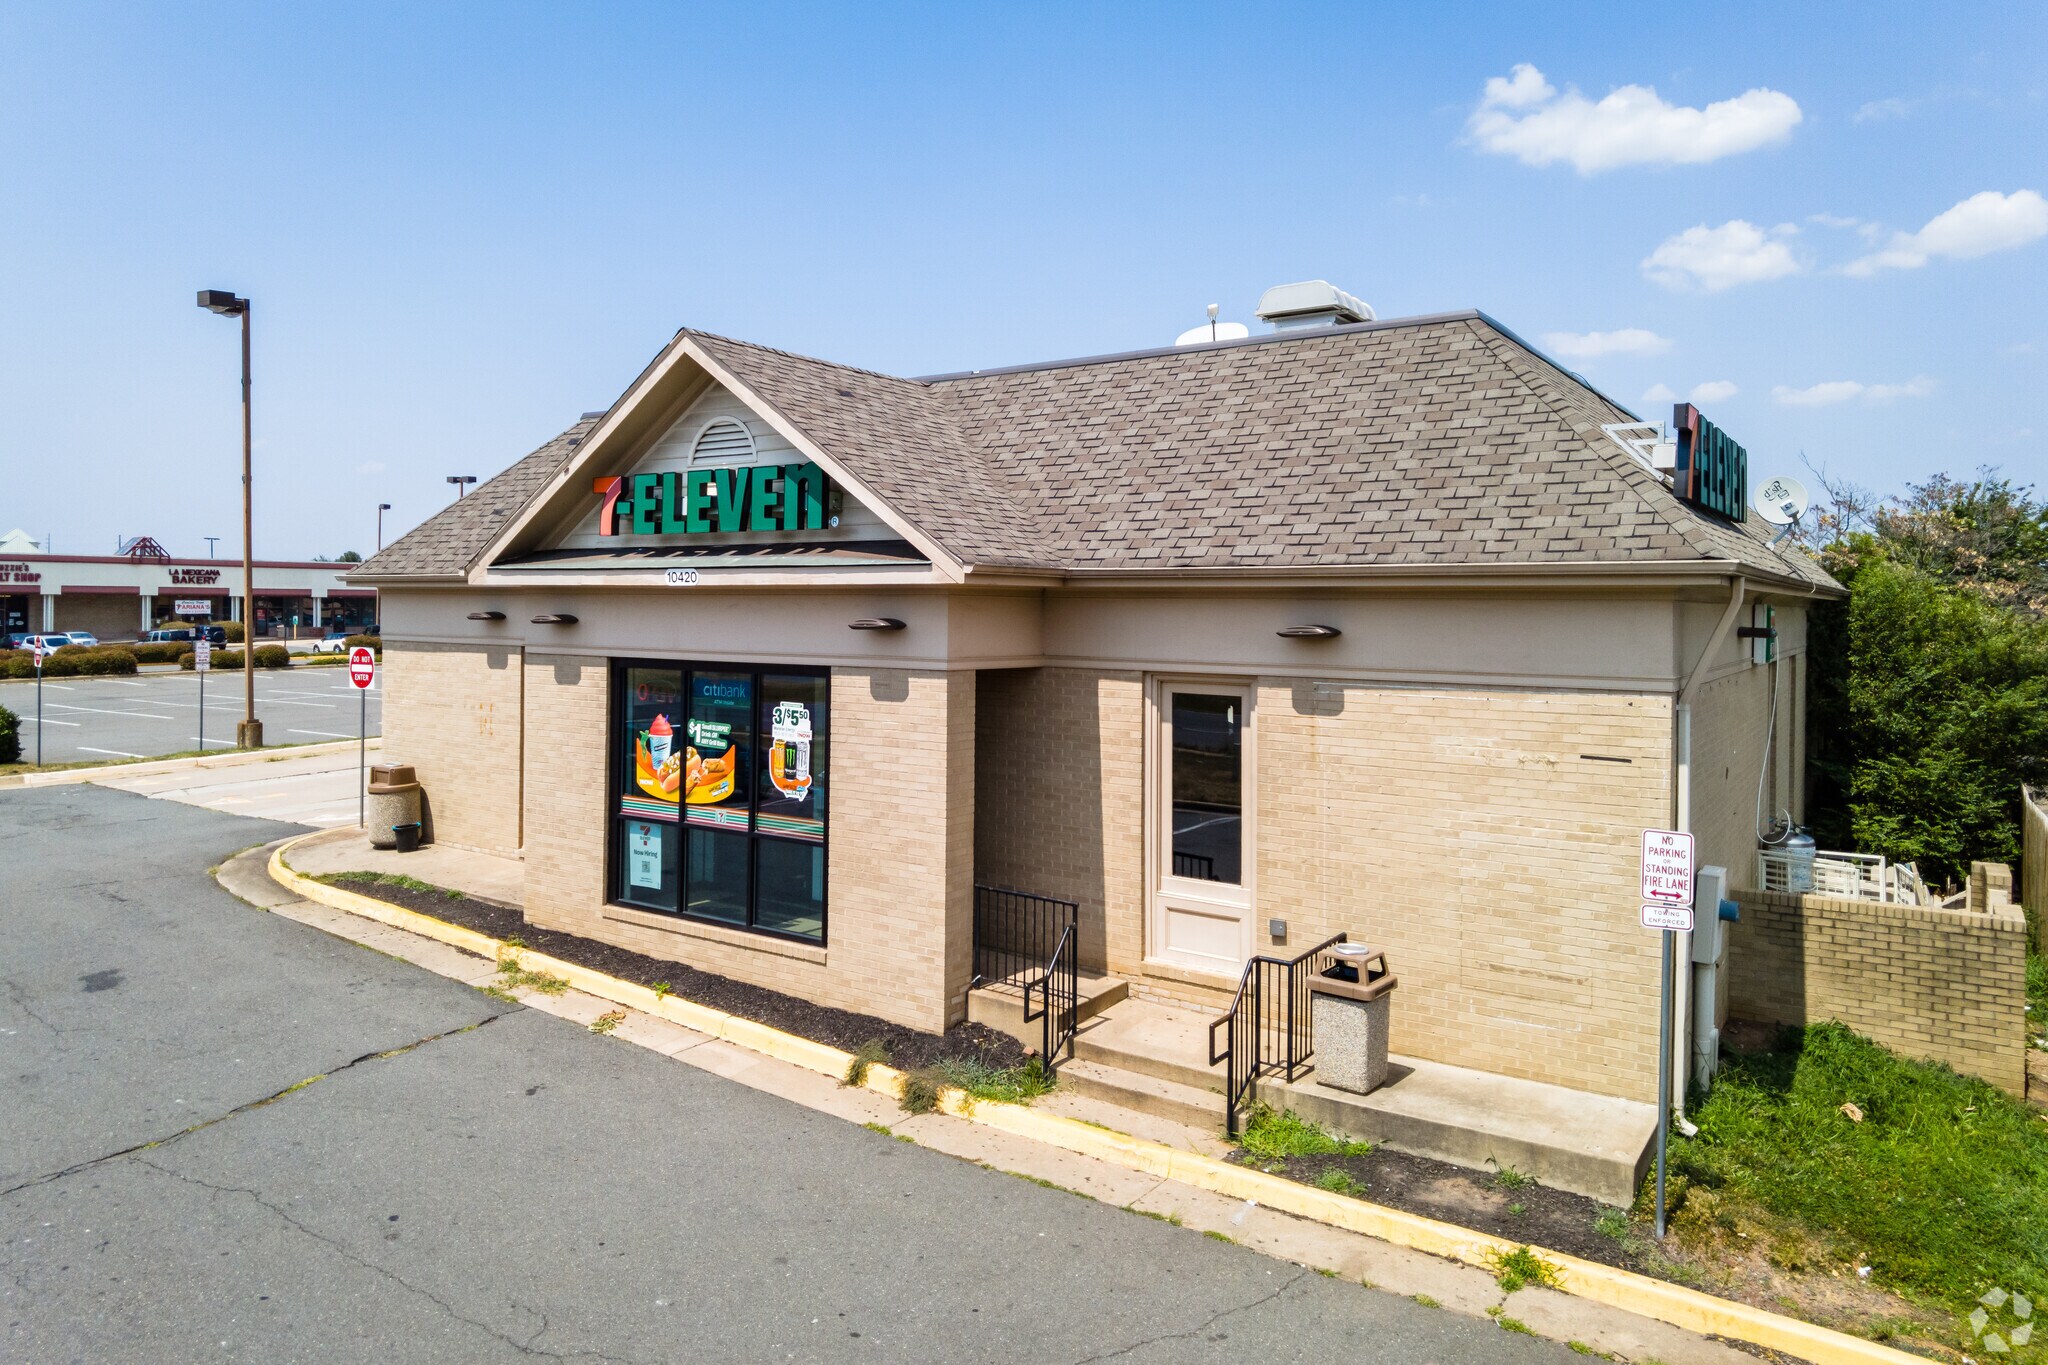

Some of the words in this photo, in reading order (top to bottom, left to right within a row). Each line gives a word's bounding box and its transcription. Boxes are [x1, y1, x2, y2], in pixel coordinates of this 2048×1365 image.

[14, 573, 41, 582] SHOP
[172, 576, 217, 584] BAKERY
[667, 572, 697, 583] 10420
[354, 673, 369, 681] ENTER
[703, 684, 746, 698] citibank
[689, 721, 701, 743] $1
[1661, 836, 1674, 846] NO
[644, 850, 658, 859] Hiring
[1648, 847, 1687, 860] PARKING
[1645, 864, 1689, 877] STANDING
[1644, 875, 1663, 888] FIRE
[1666, 878, 1689, 891] LANE
[1648, 918, 1685, 926] ENFORCED
